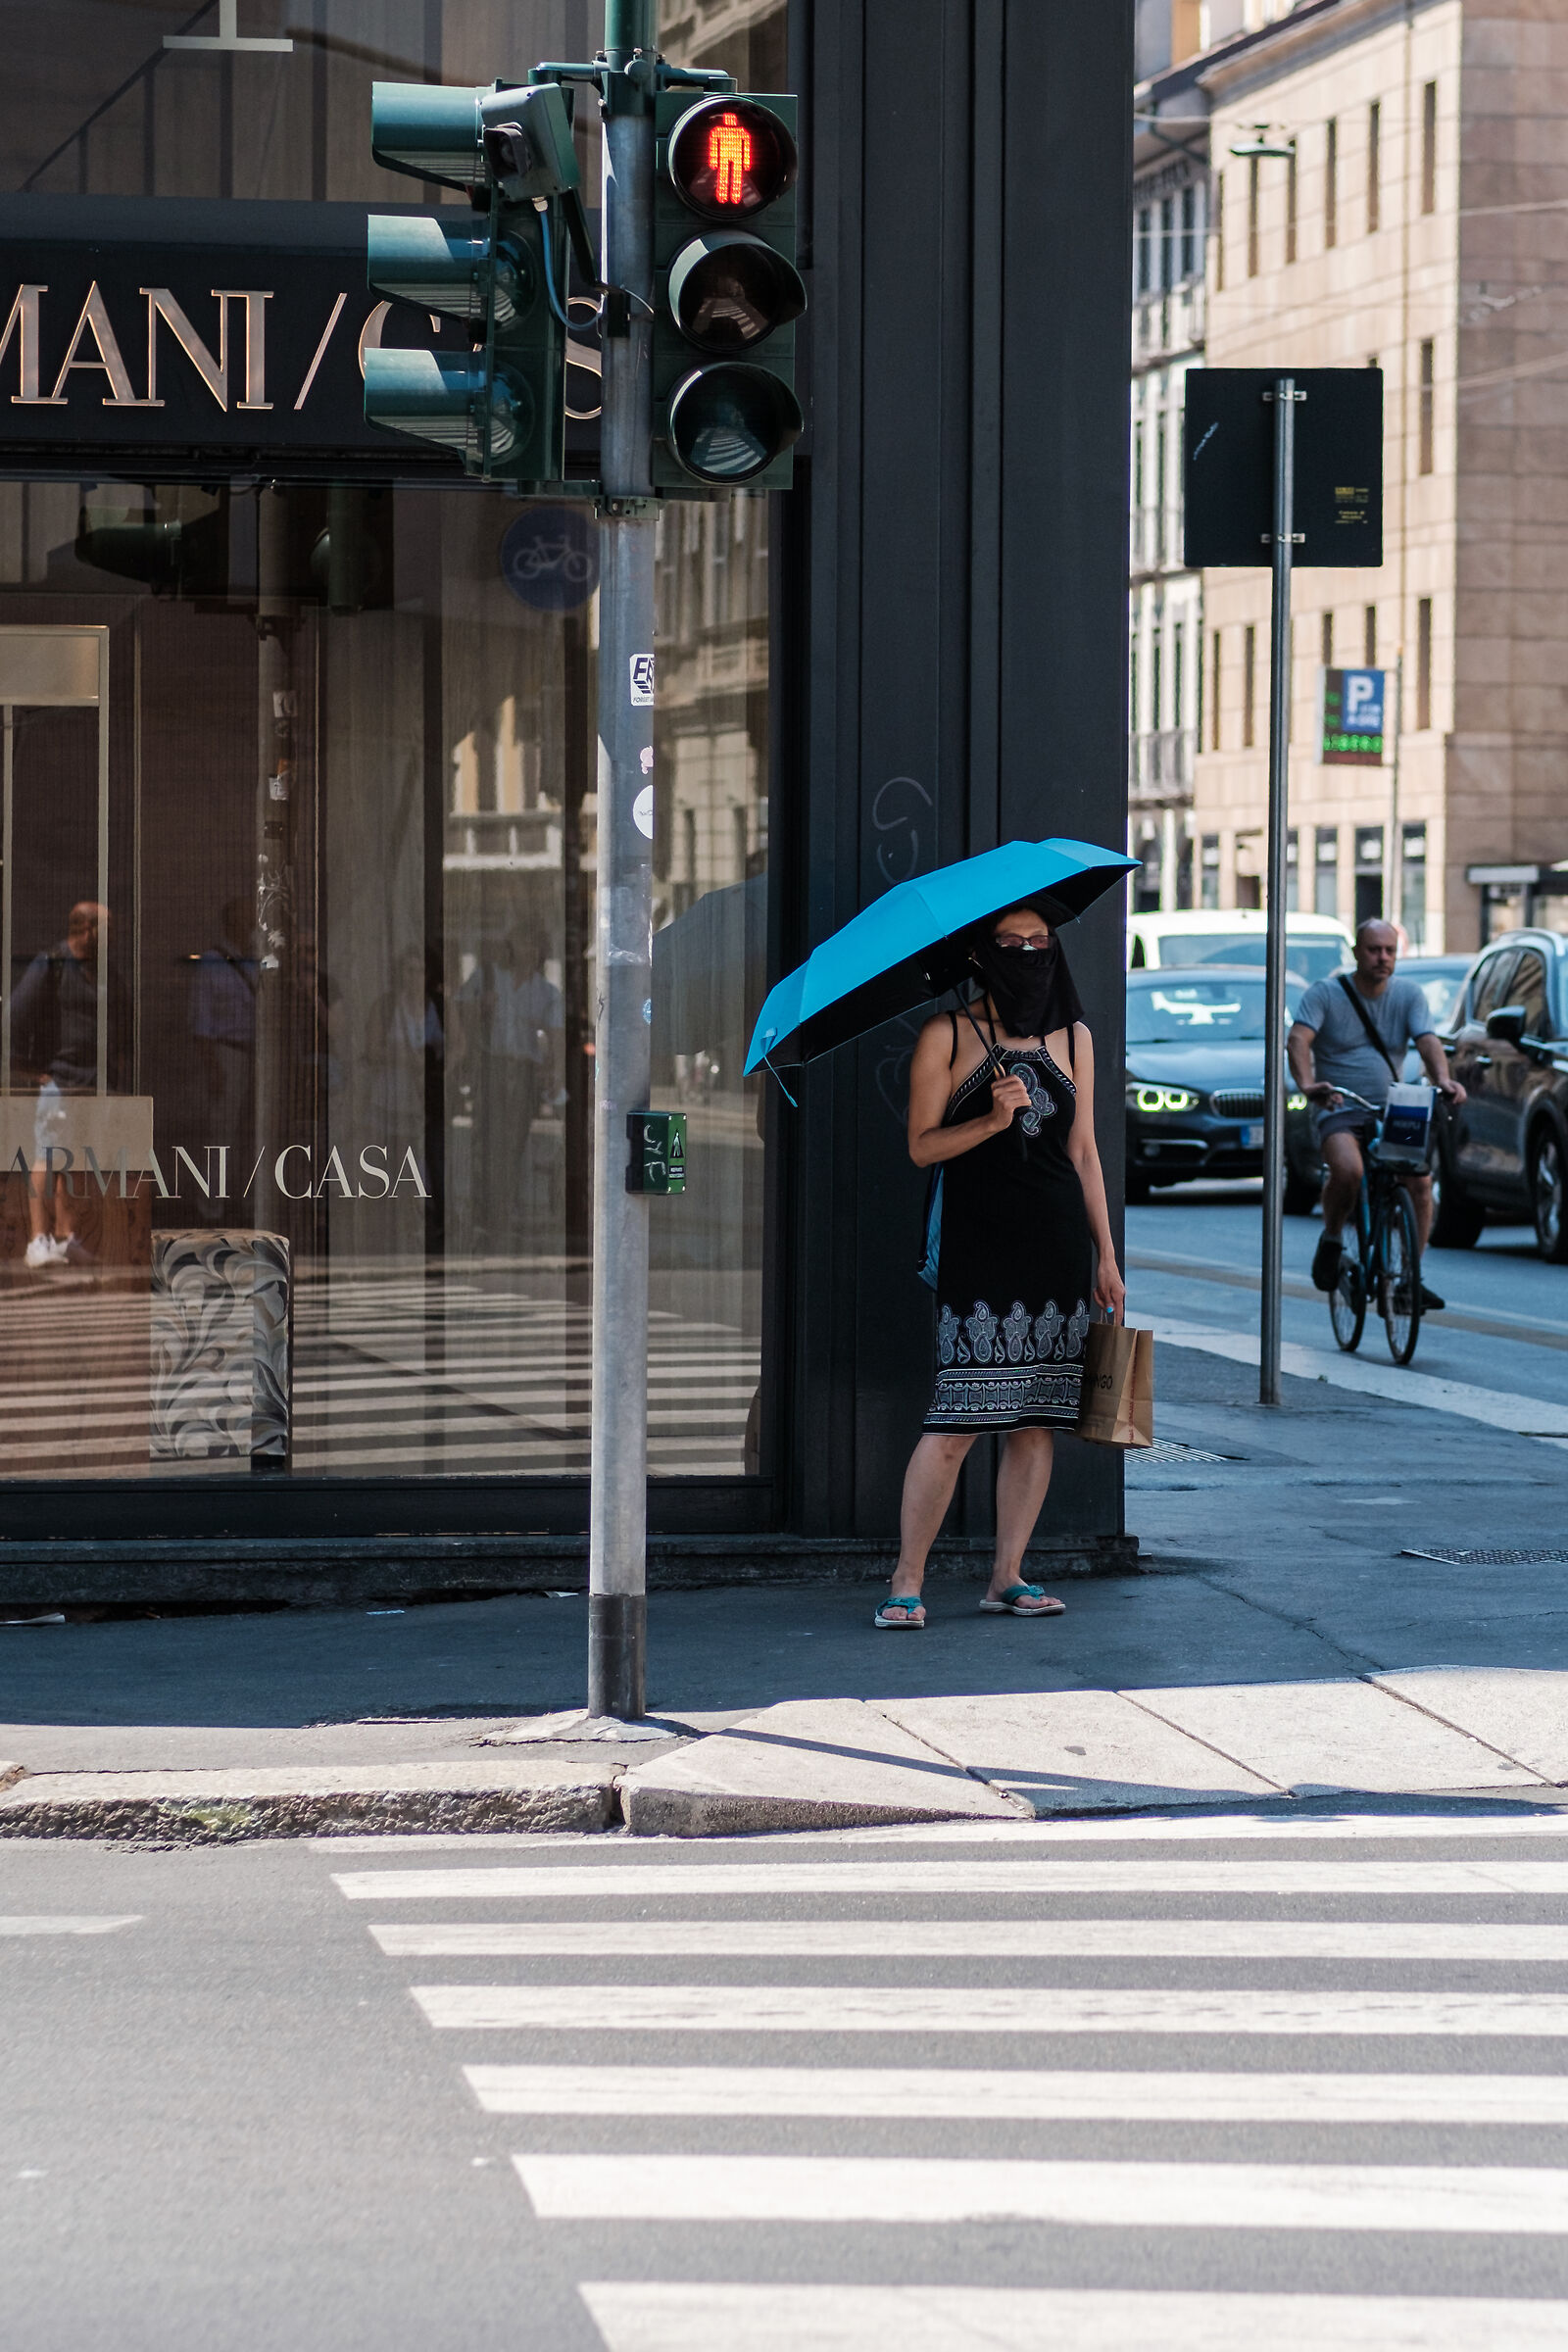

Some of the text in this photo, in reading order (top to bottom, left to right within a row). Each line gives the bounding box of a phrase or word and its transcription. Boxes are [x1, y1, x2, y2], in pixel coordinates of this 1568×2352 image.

[1348, 675, 1374, 712] P
[6, 1145, 432, 1199] ARMANI / CASA
